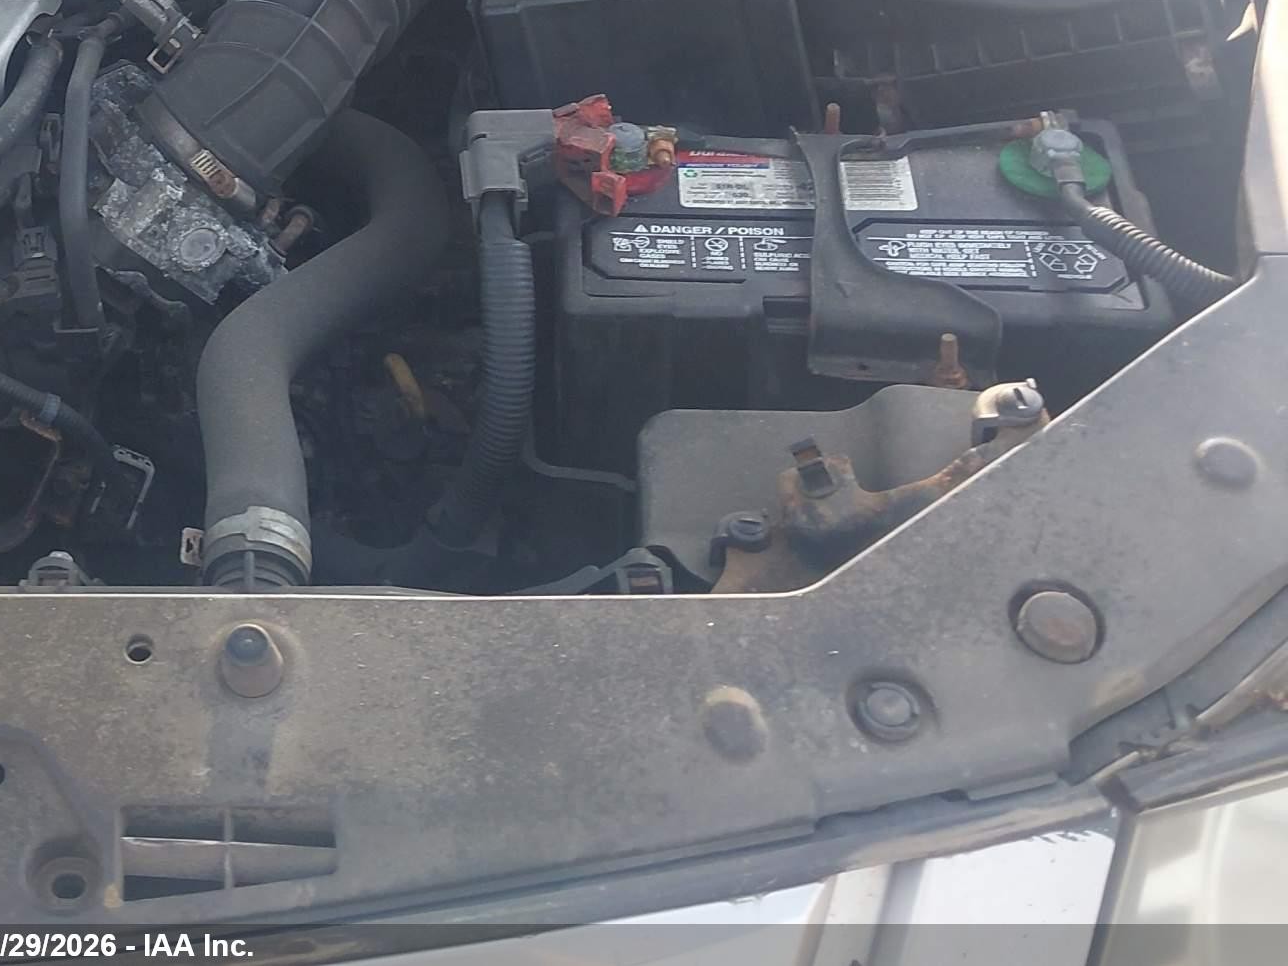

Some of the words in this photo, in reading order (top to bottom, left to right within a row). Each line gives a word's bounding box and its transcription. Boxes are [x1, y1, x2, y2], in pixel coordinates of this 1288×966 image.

[650, 225, 712, 234] DANGER
[715, 226, 726, 234] /
[727, 227, 785, 236] POISON
